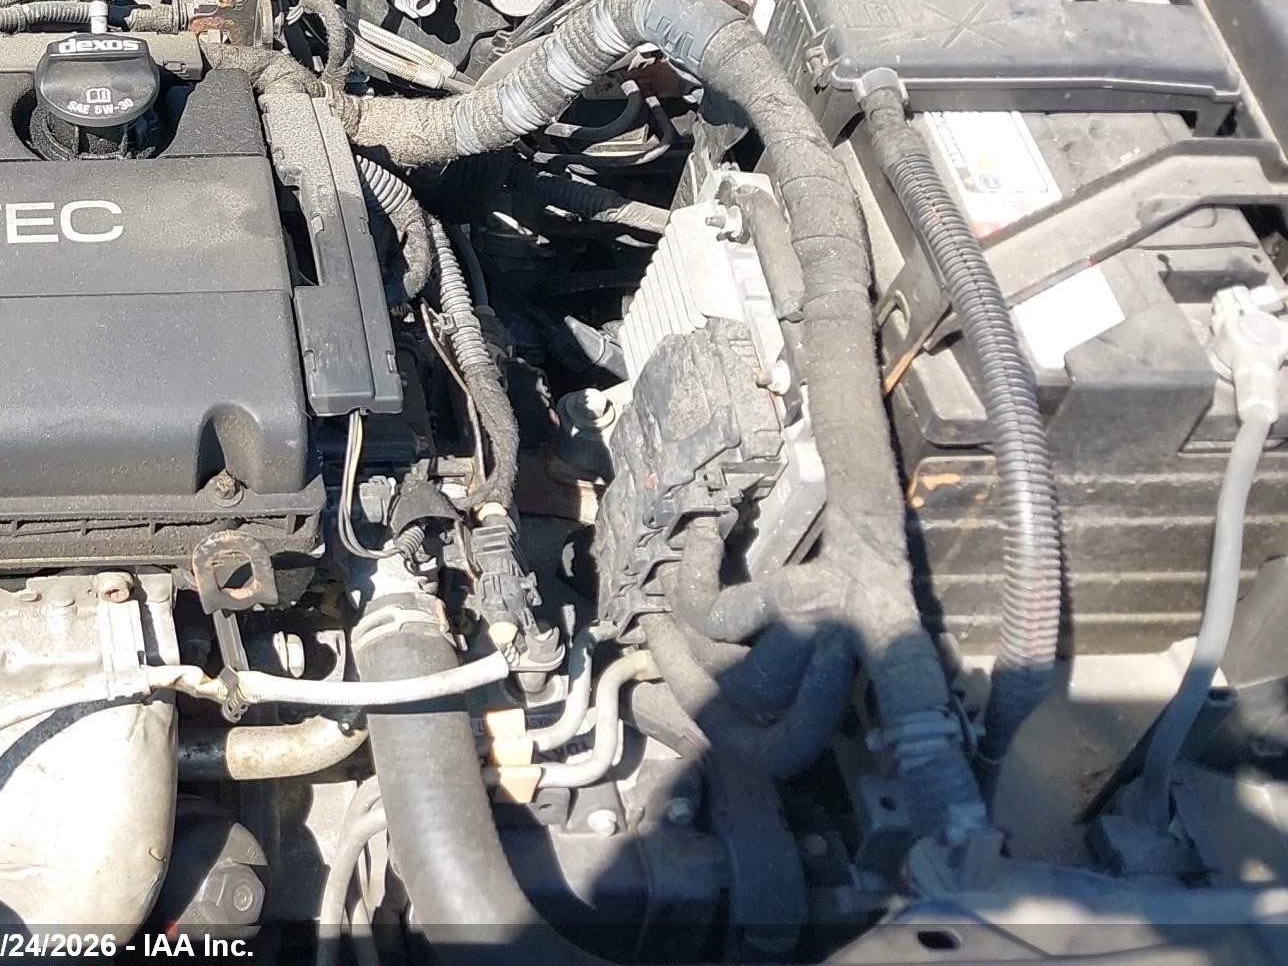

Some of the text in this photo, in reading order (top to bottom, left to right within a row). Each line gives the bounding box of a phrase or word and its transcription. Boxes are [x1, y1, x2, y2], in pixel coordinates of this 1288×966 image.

[58, 38, 141, 54] dexos
[67, 97, 135, 115] SAE 5W-30
